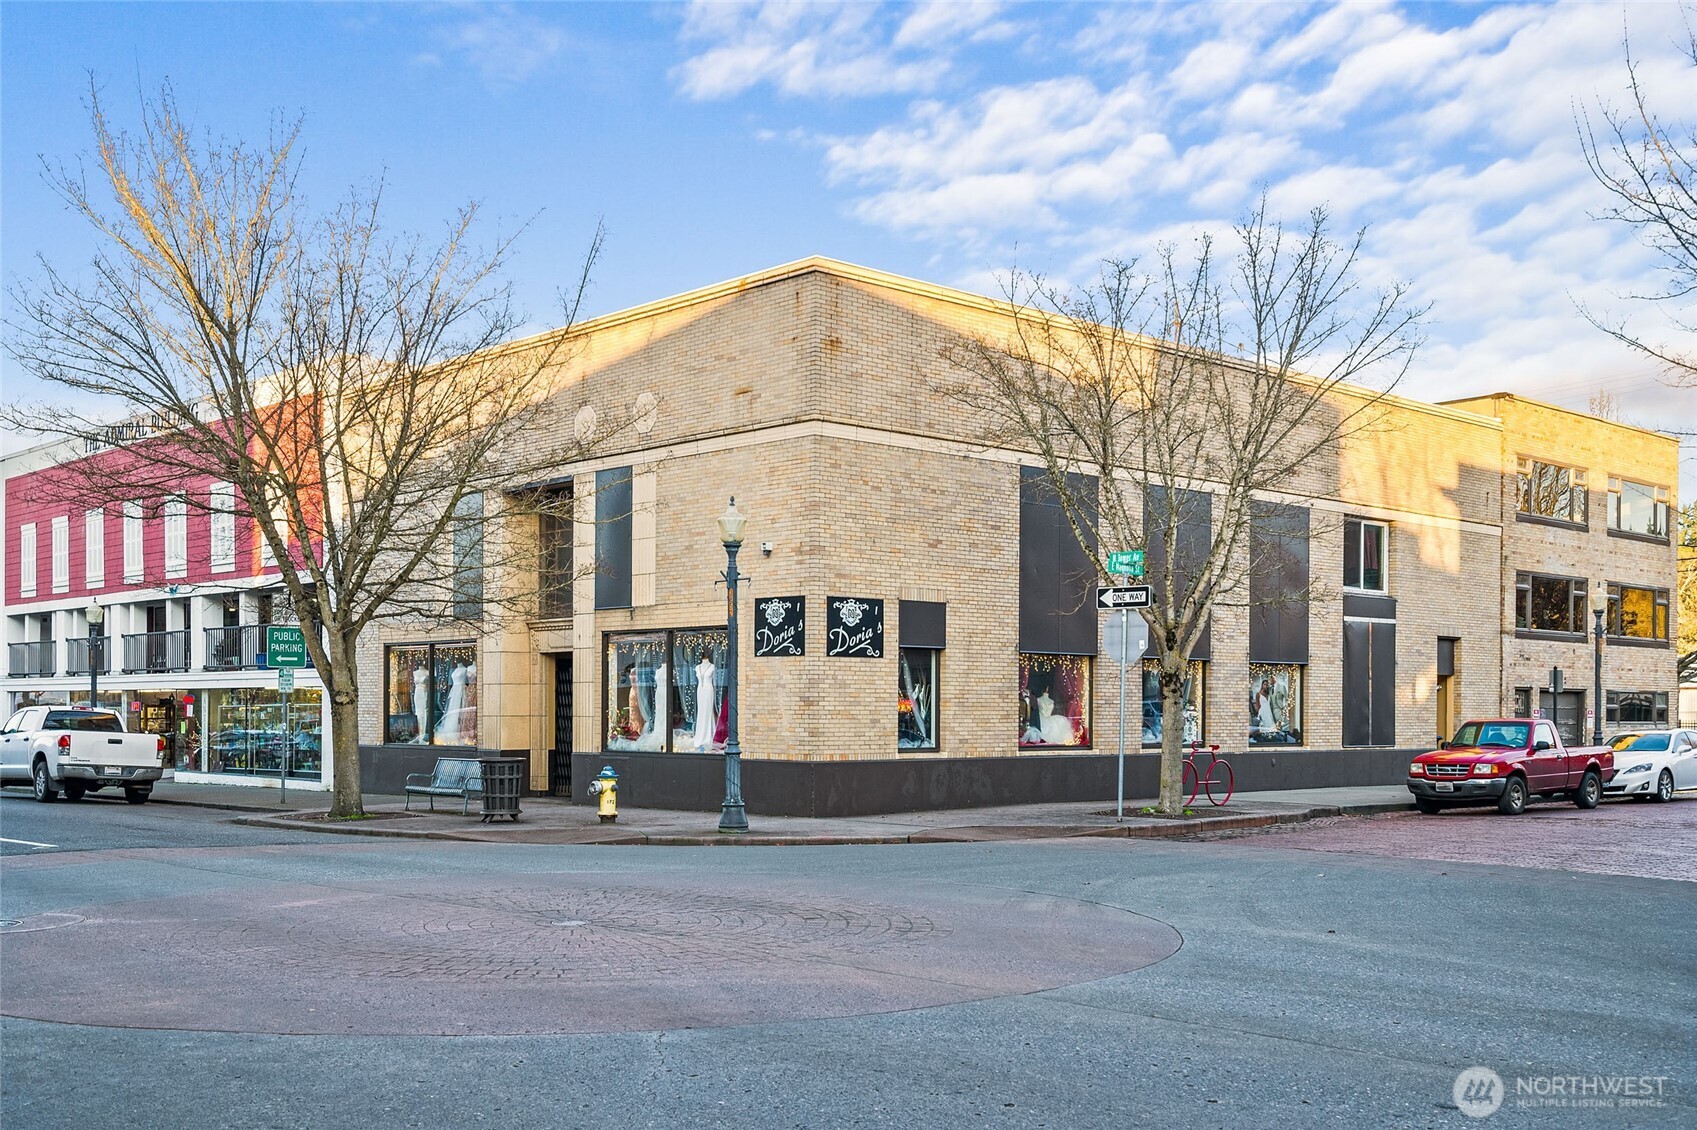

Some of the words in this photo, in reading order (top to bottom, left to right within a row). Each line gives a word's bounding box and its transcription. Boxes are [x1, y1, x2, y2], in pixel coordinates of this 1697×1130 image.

[1129, 593, 1144, 601] WAY
[273, 631, 301, 641] PUBLIC
[271, 643, 303, 653] PARKING
